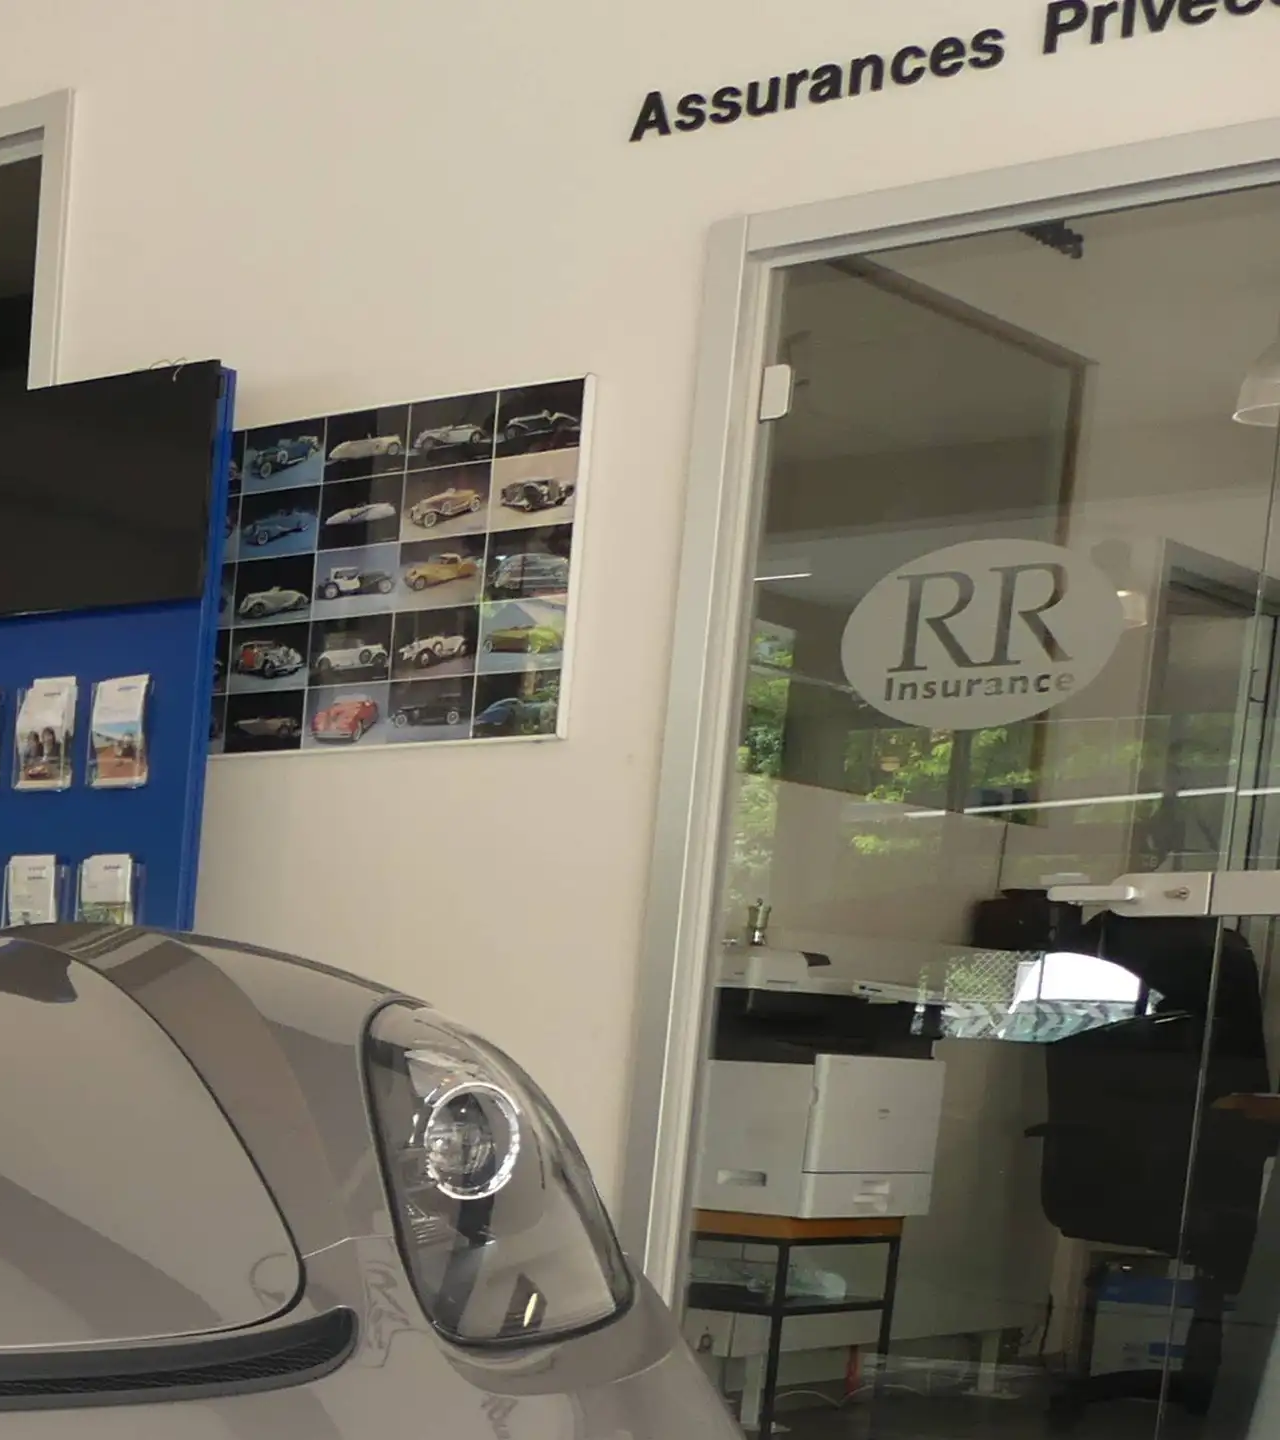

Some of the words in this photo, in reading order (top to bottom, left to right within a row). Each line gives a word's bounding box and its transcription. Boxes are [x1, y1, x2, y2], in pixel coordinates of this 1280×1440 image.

[628, 28, 1005, 142] Assurances
[1042, 0, 1280, 54] Prive
[886, 562, 1074, 673] RR
[884, 673, 1076, 701] Insurance
